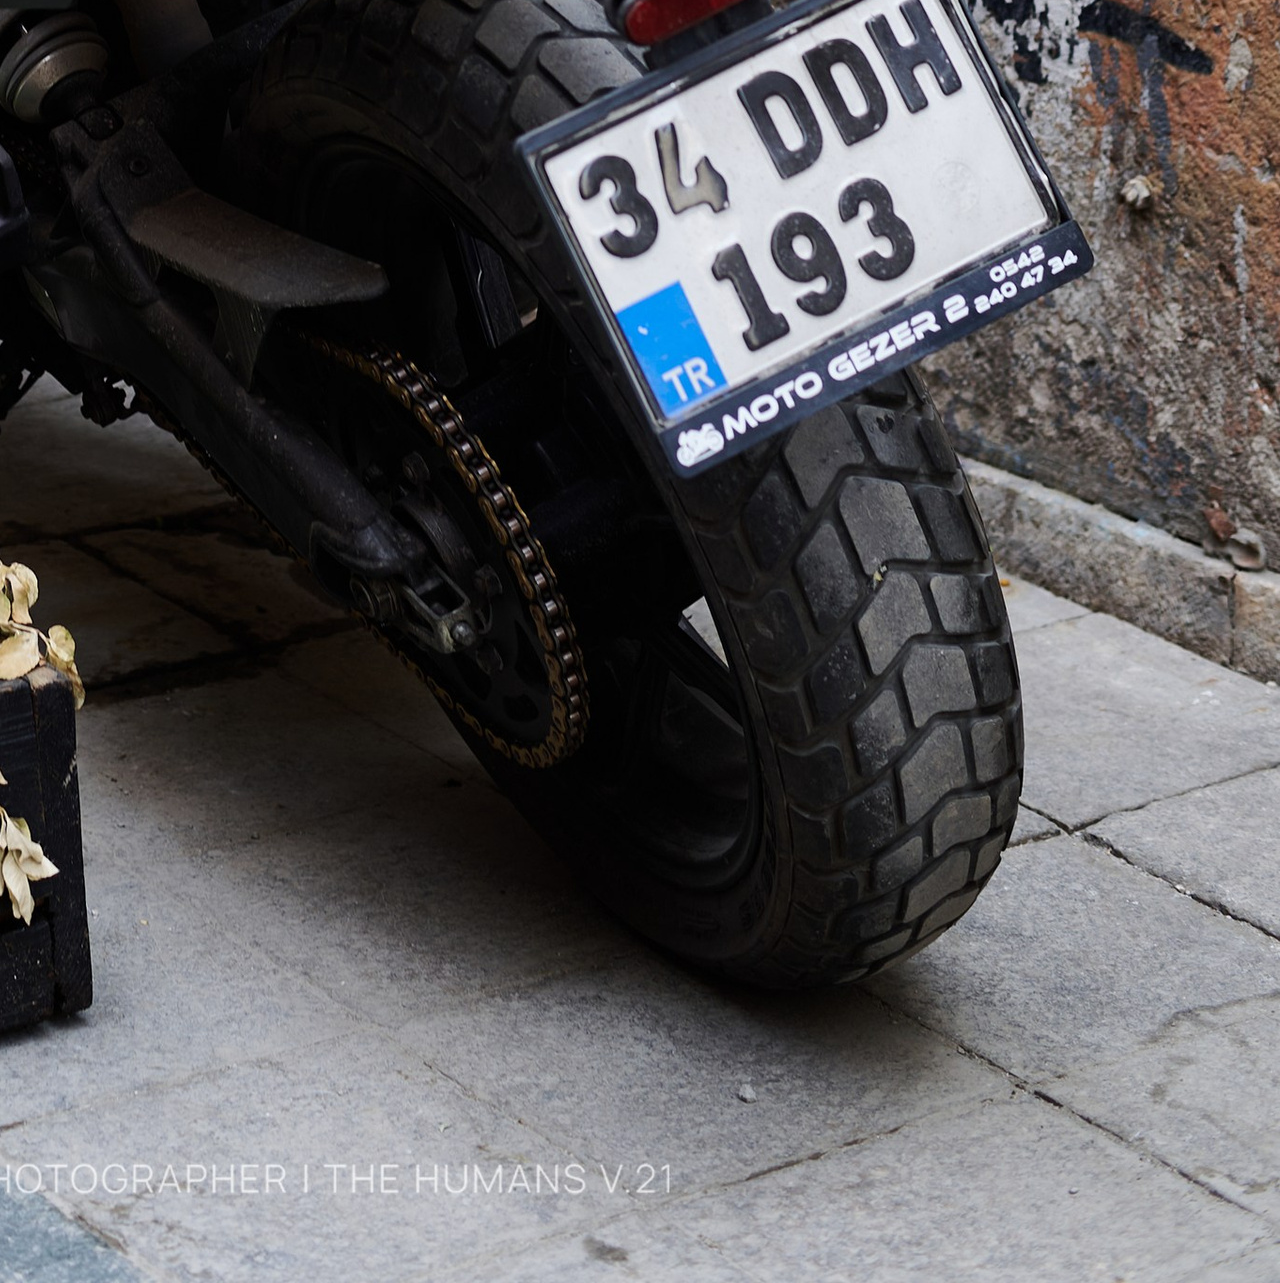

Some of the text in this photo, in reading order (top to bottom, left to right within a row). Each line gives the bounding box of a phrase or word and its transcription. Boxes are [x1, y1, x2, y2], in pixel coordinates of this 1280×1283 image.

[579, 122, 729, 258] 34
[711, 178, 916, 351] 193
[974, 249, 1078, 314] 240 47 34
[989, 245, 1045, 283] 0542
[661, 357, 716, 404] TR
[722, 294, 969, 441] MOTO GEZER 2
